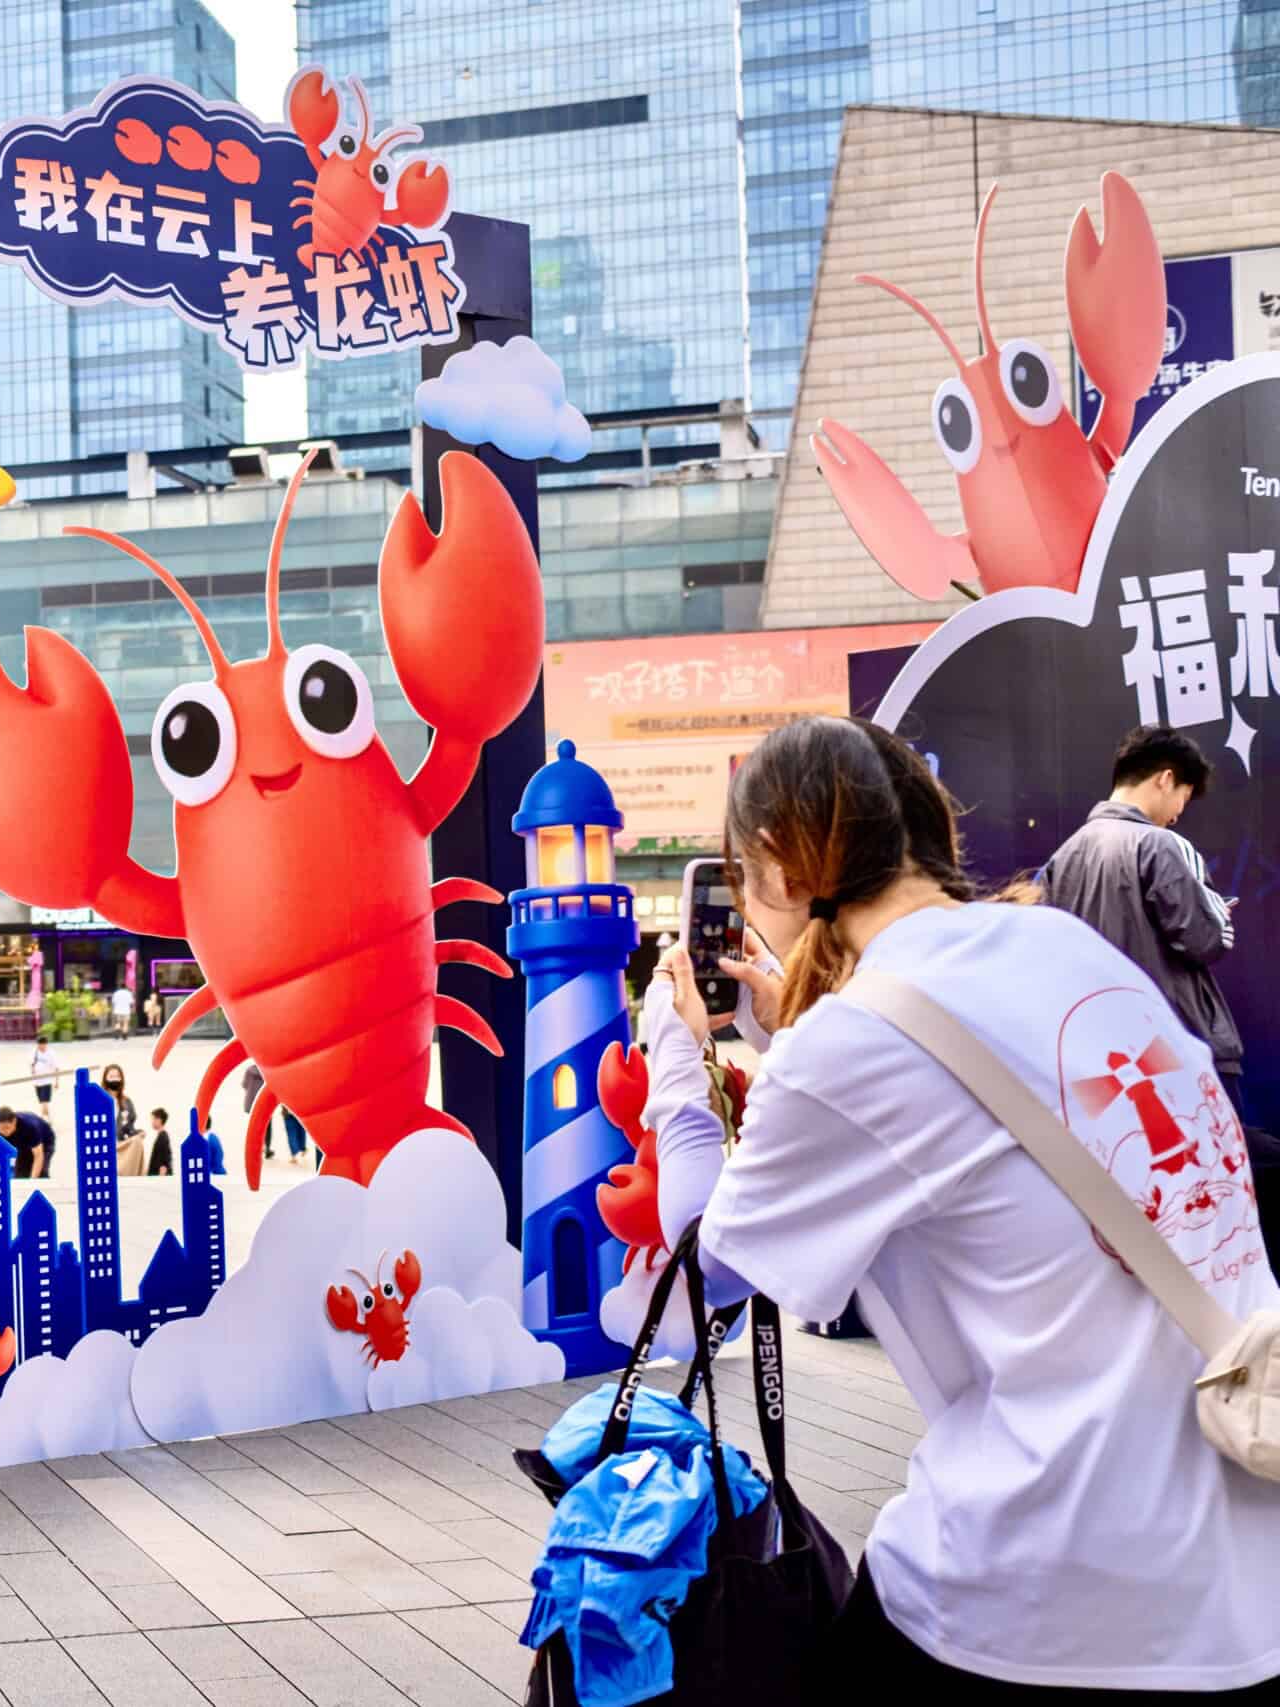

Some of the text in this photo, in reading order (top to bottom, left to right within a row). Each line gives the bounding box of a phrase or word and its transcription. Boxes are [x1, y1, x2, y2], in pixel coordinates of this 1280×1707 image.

[13, 158, 275, 266] 我在云上
[220, 241, 458, 365] 养龙虾
